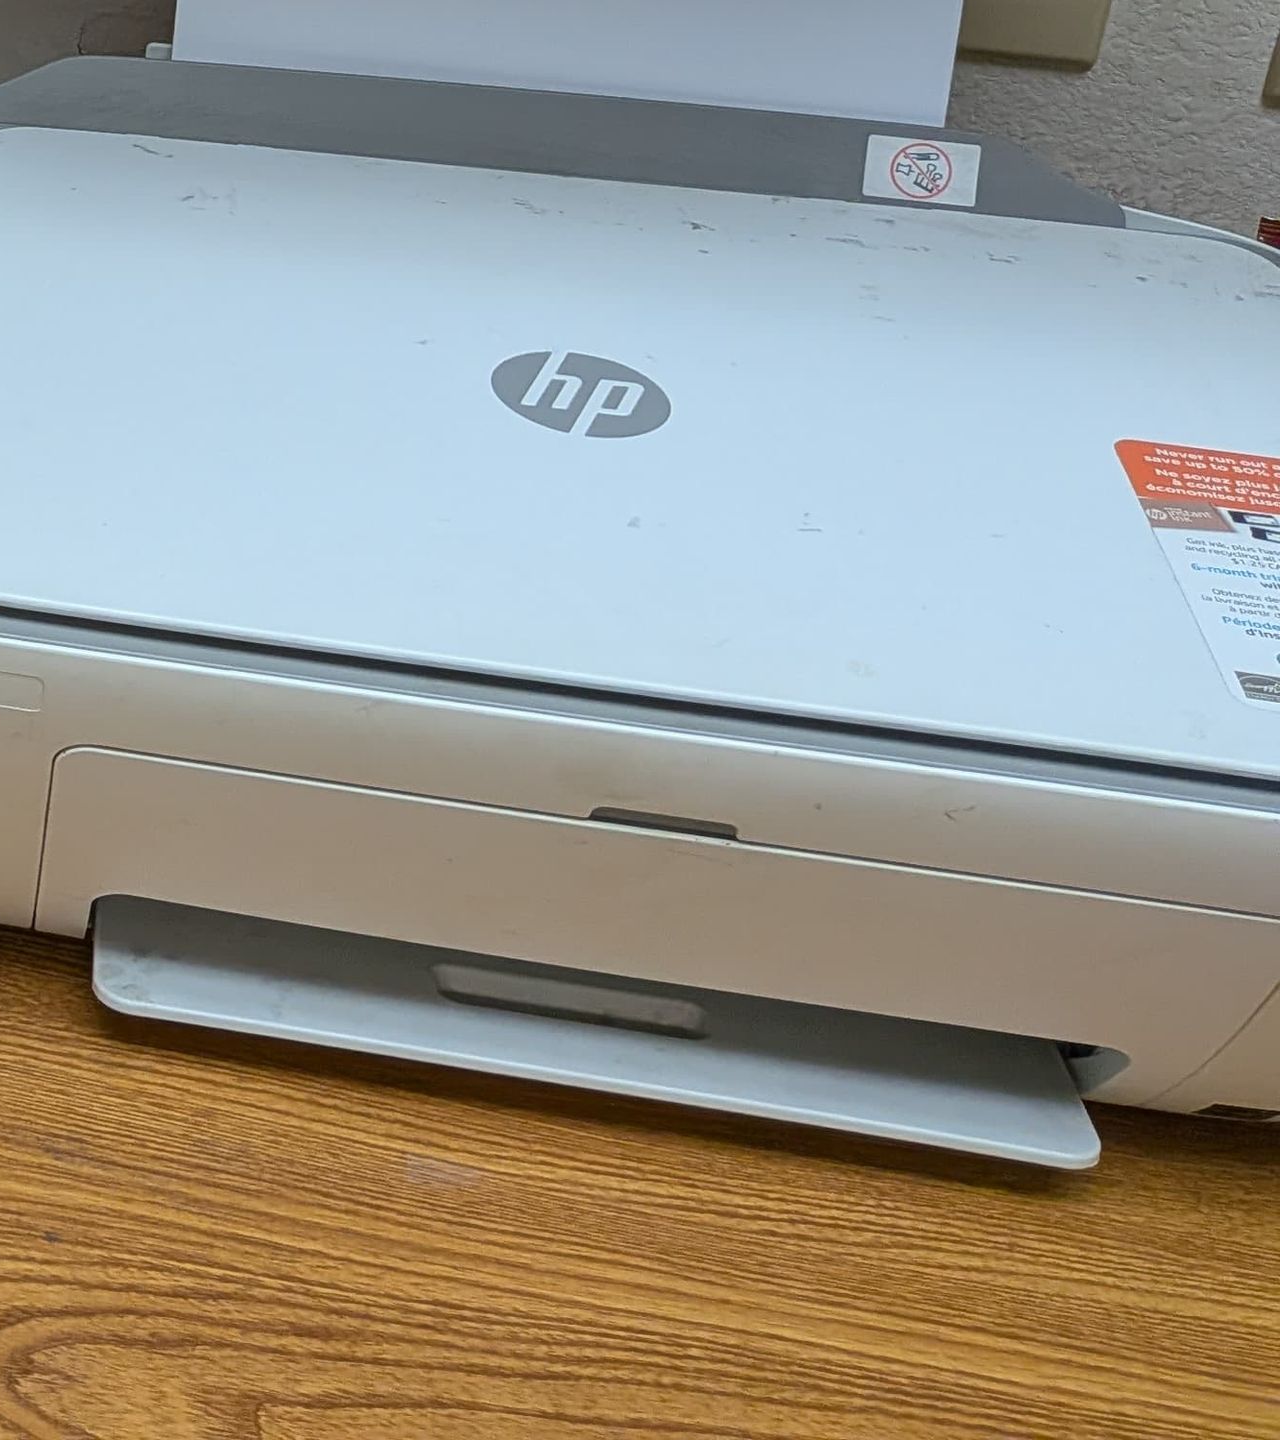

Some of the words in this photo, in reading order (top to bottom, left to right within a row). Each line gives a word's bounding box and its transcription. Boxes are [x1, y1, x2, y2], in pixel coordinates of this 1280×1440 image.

[518, 350, 646, 438] hp
[1143, 455, 1181, 466] save
[1185, 459, 1207, 470] up
[1209, 462, 1228, 472] to
[1231, 465, 1270, 478] 50%
[1155, 448, 1204, 461] Never
[1208, 455, 1236, 465] run
[1239, 458, 1268, 470] out
